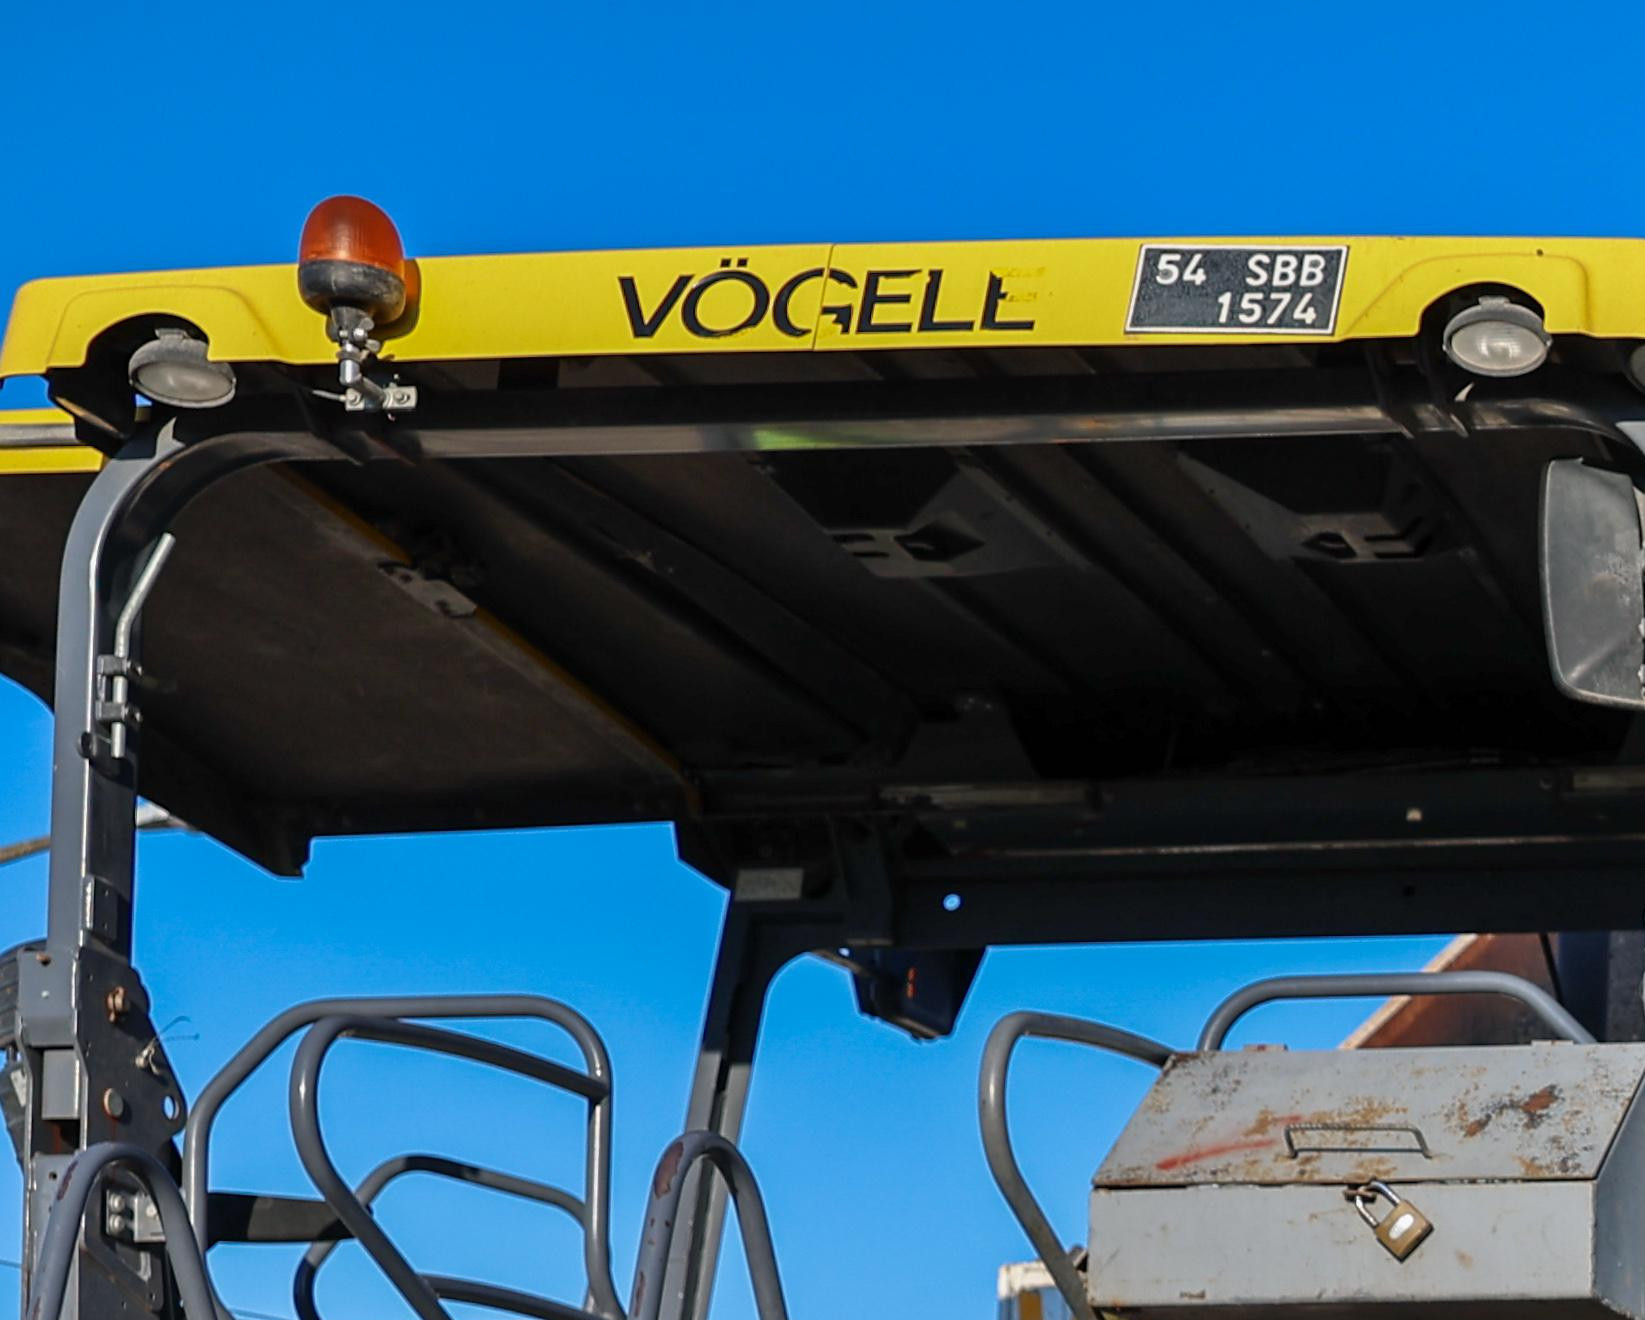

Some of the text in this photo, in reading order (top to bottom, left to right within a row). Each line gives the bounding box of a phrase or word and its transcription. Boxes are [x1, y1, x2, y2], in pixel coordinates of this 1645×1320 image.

[1155, 253, 1326, 287] 54 SBB
[1217, 291, 1317, 325] 1574
